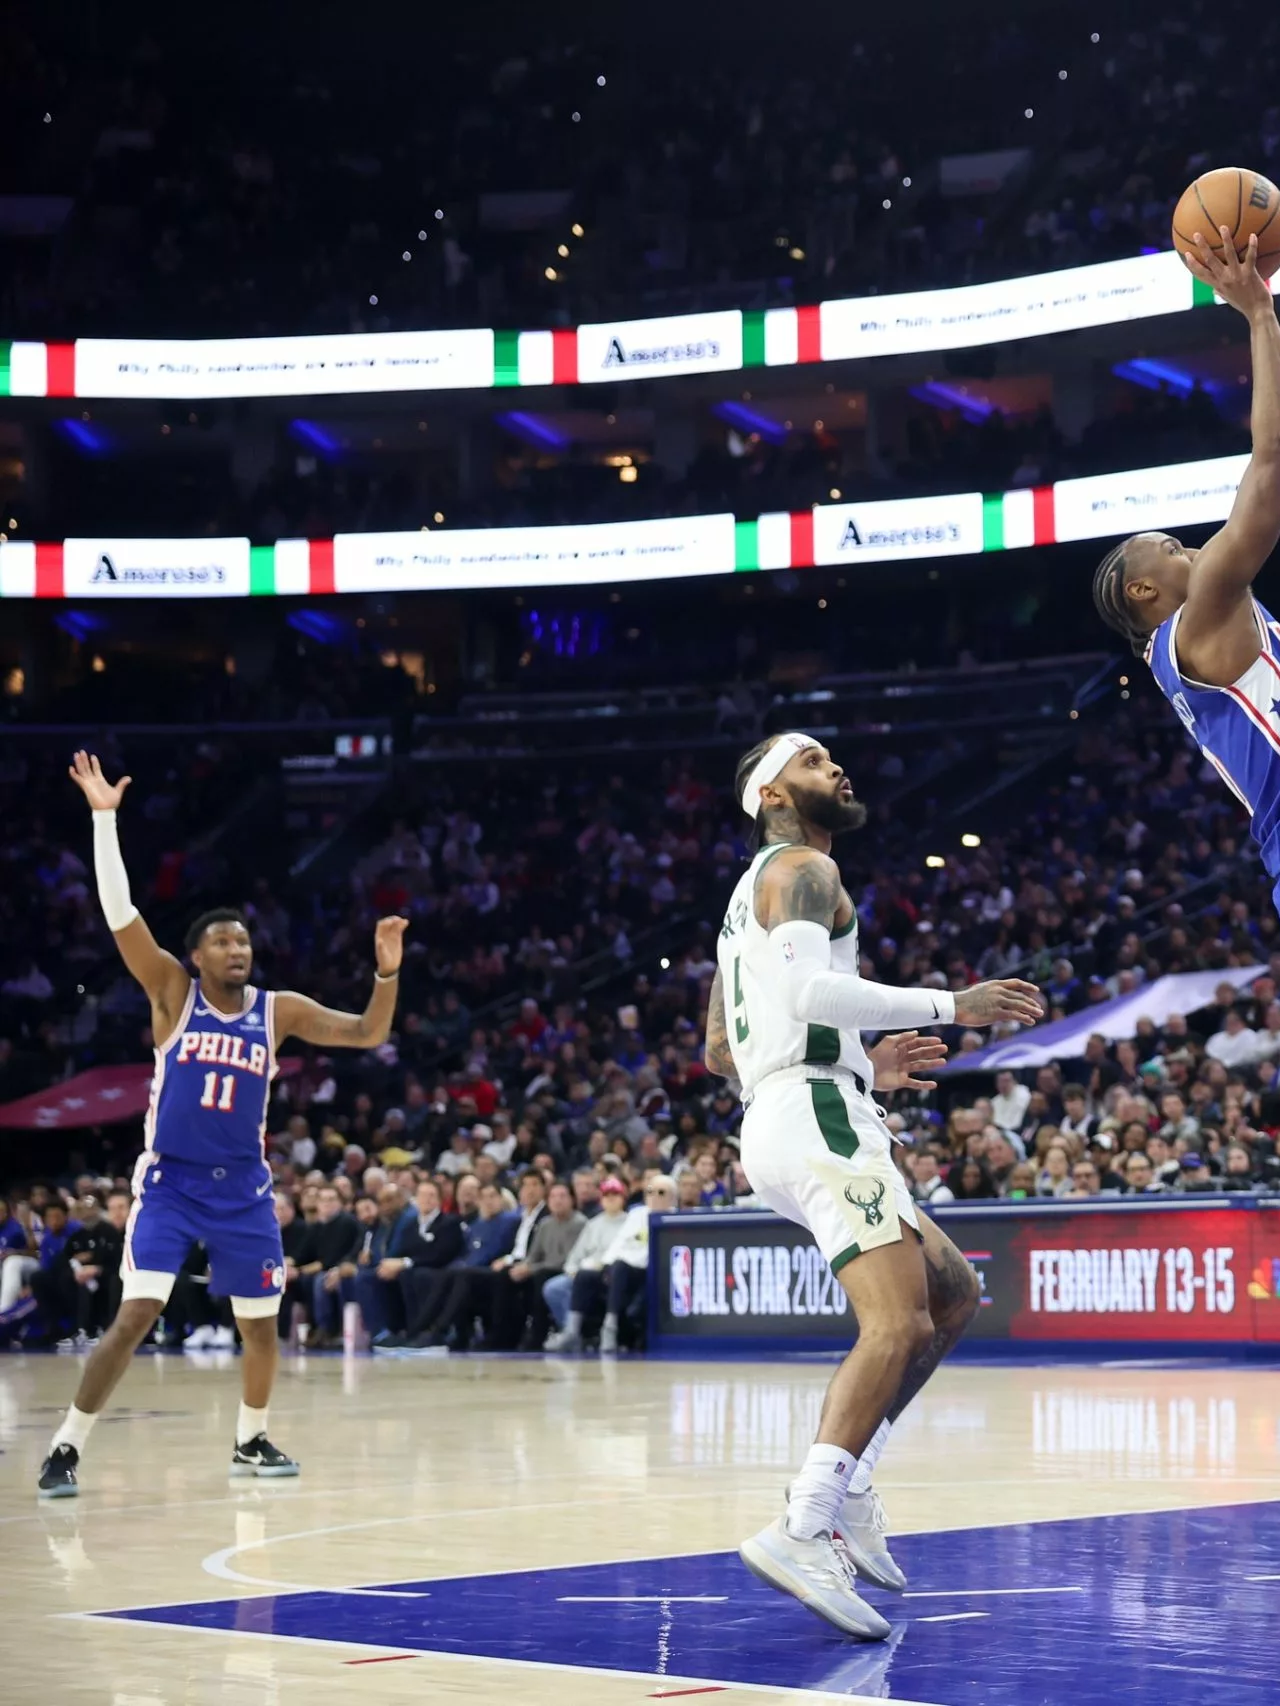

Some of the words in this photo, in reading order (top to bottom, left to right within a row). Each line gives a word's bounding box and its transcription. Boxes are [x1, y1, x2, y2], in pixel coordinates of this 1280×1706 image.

[177, 1032, 268, 1075] PHILA
[200, 1071, 235, 1112] 11
[1029, 1249, 1160, 1313] FEBRUARY
[1163, 1247, 1236, 1314] 13-15
